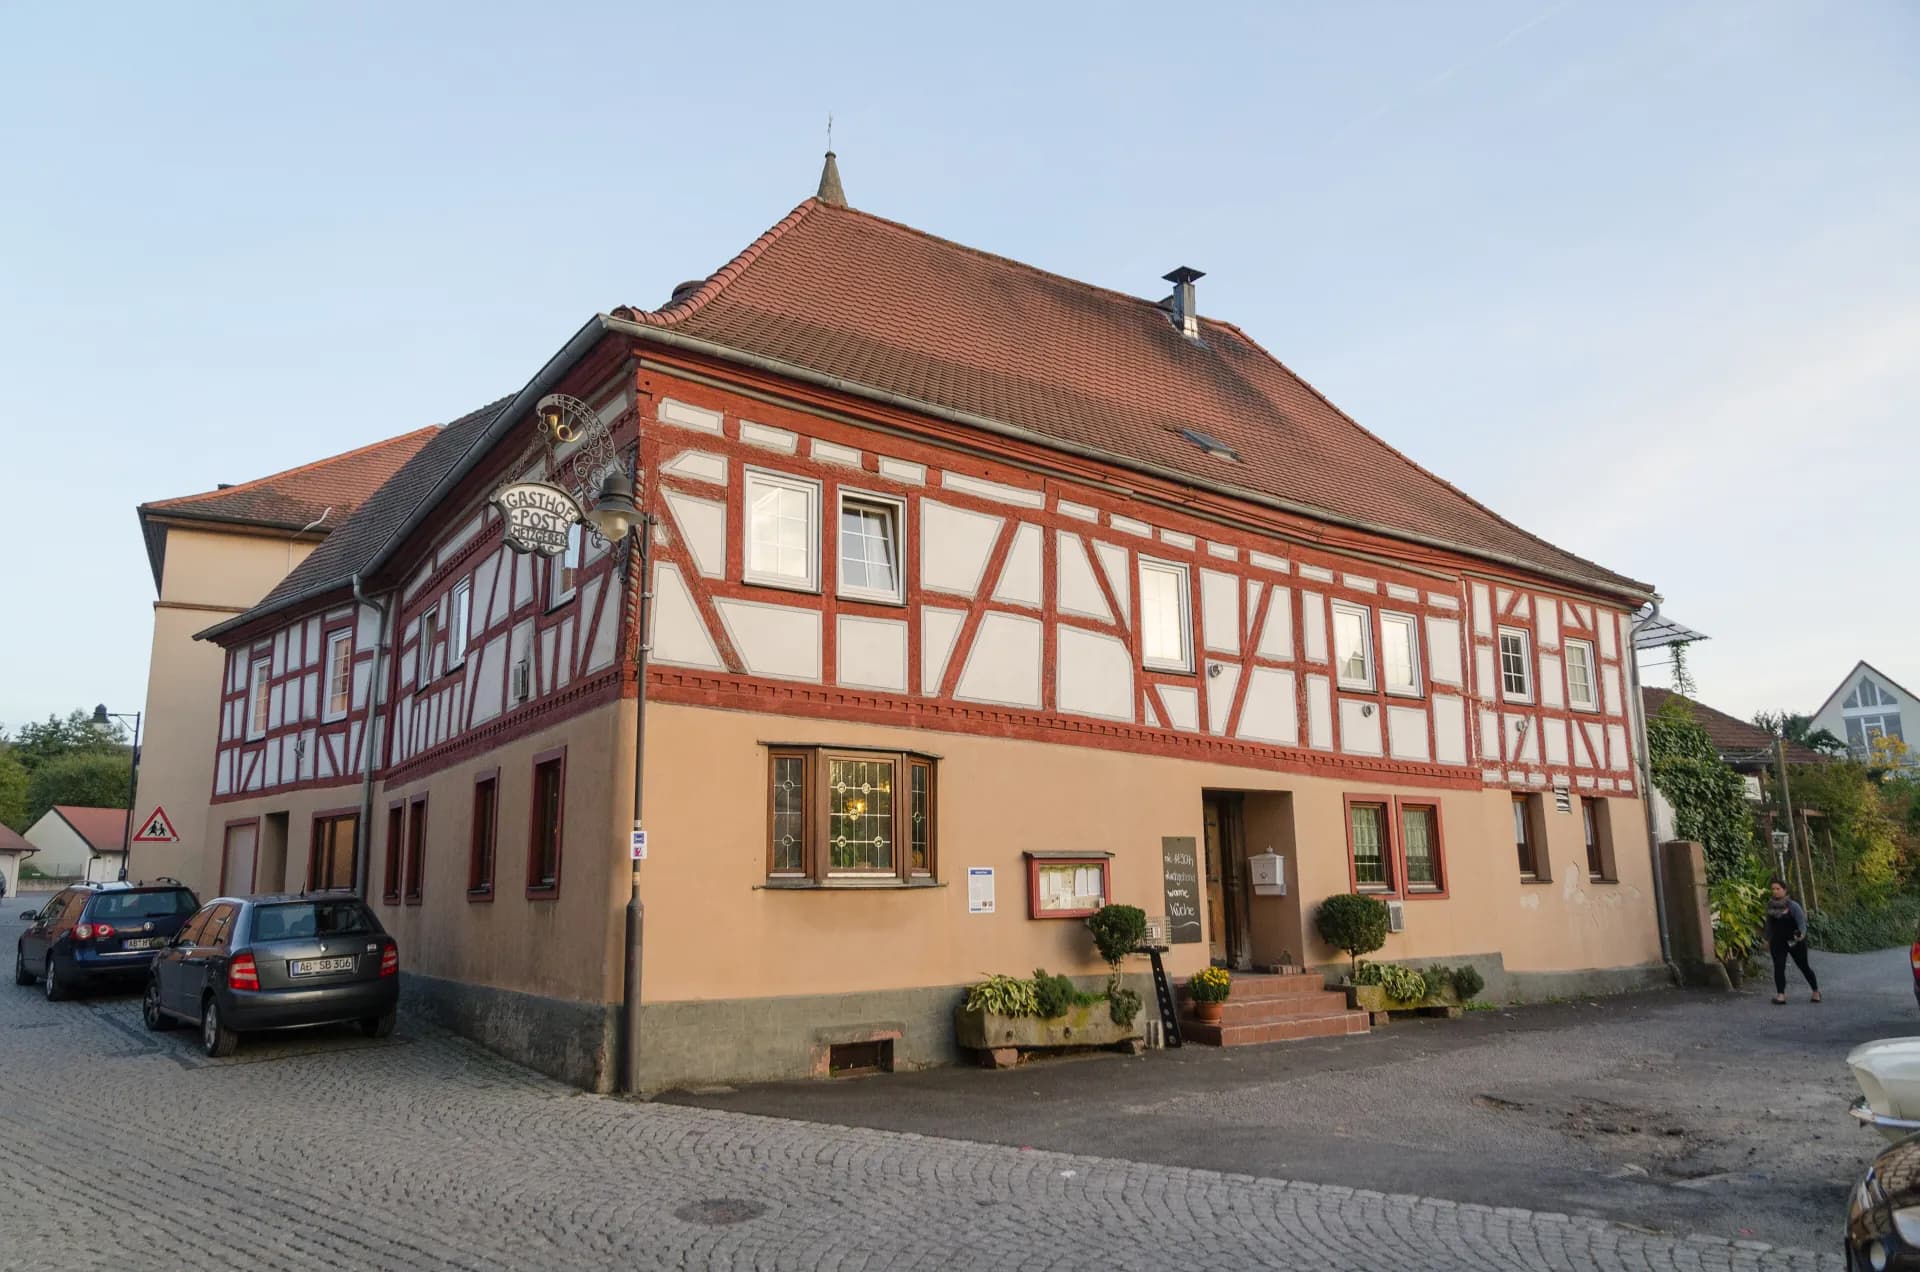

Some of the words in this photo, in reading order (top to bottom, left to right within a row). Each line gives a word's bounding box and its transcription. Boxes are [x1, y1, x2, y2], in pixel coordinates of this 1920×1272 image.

[506, 490, 576, 518] GASTHOF
[520, 509, 560, 531] POST
[512, 526, 565, 544] METZGEREI
[1169, 902, 1195, 917] Küche
[300, 961, 313, 972] AB
[320, 960, 332, 970] SB
[333, 959, 351, 969] 306
